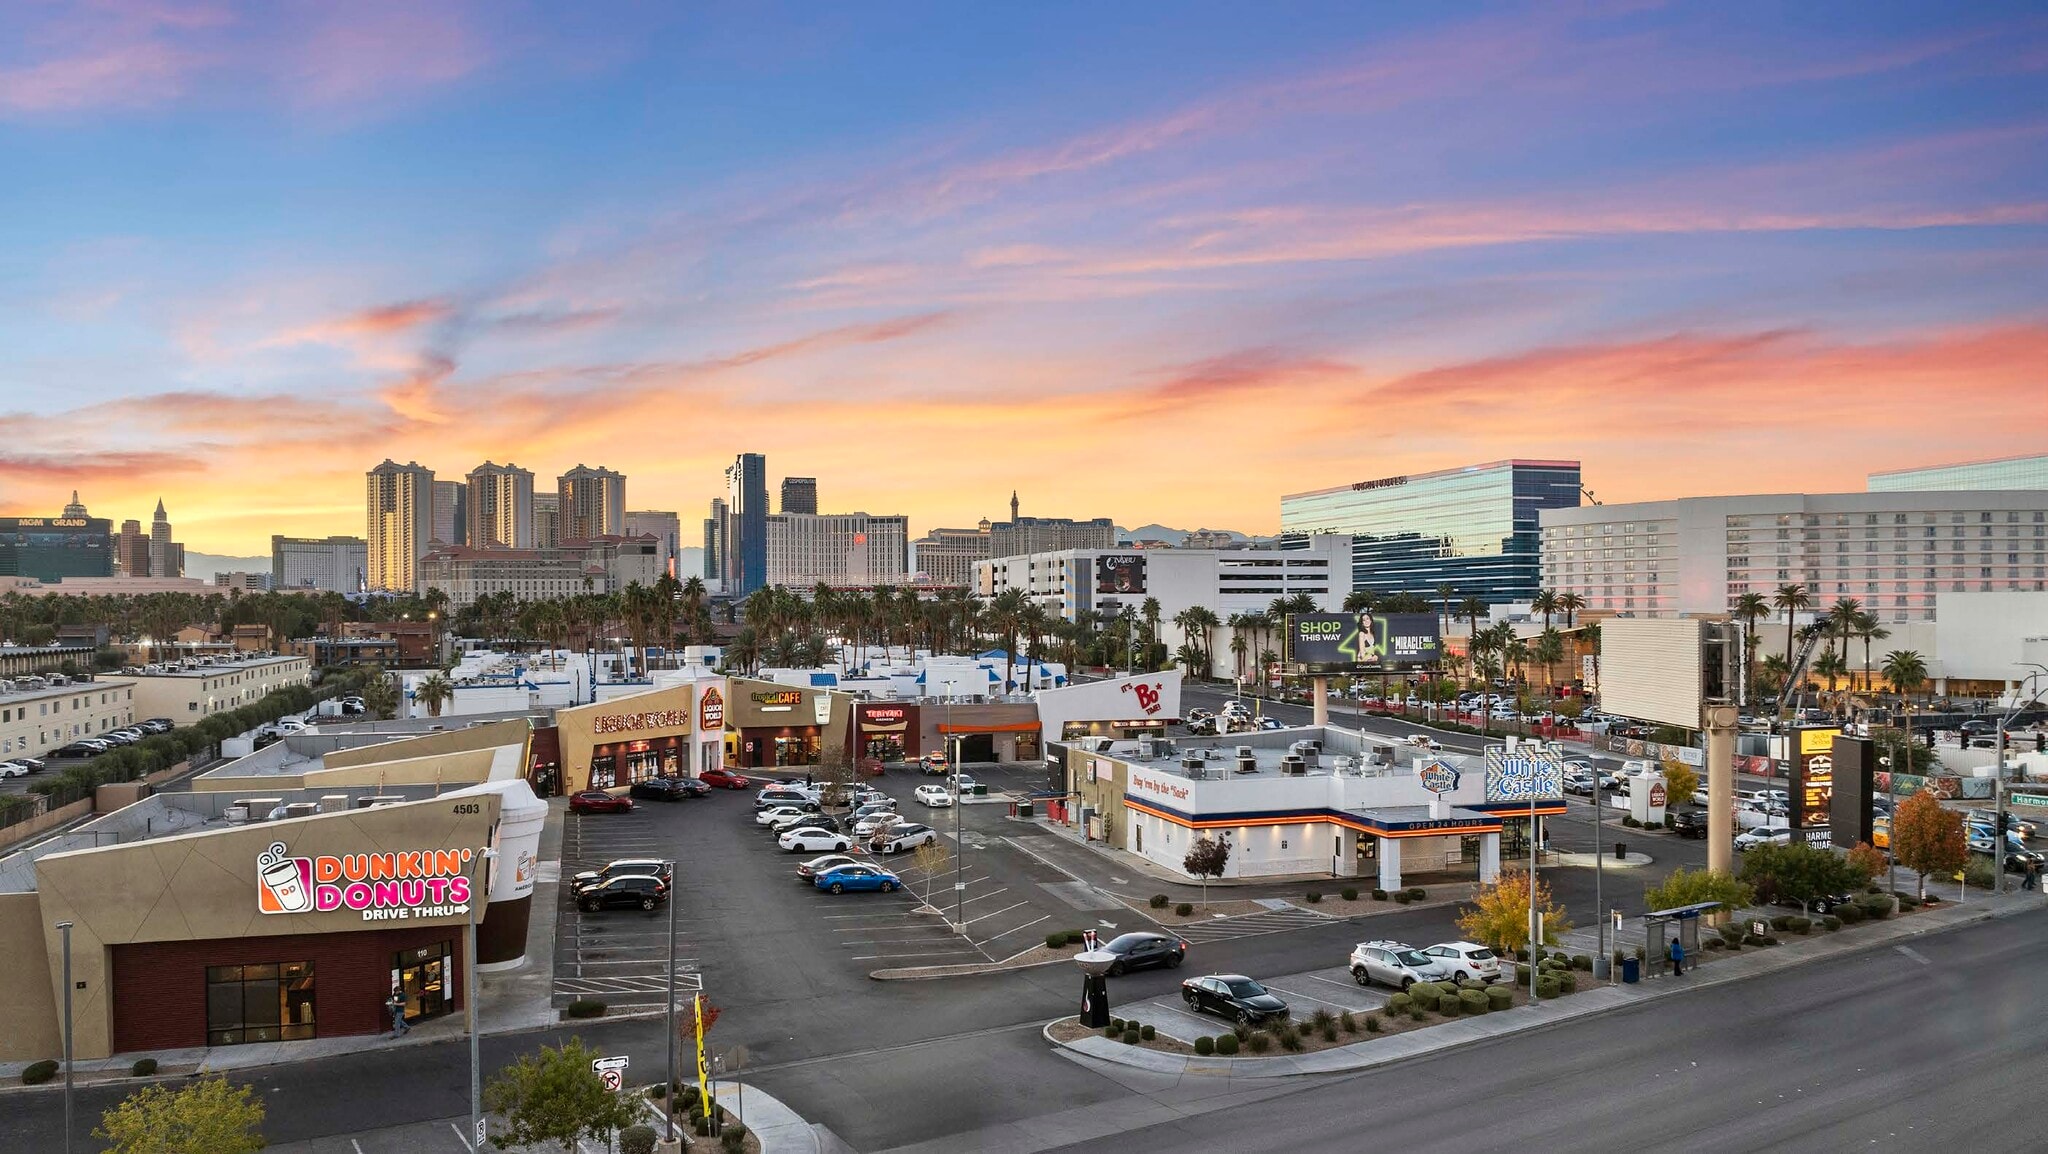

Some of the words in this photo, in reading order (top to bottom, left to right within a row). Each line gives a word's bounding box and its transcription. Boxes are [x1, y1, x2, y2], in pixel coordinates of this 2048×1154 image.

[18, 519, 44, 527] MGM
[52, 519, 87, 527] GRAND
[1300, 621, 1342, 634] SHOP
[1322, 633, 1342, 641] WAY
[1395, 636, 1423, 650] MIRACLE
[1120, 682, 1133, 694] IT'S
[778, 692, 801, 704] CAFE
[865, 709, 903, 718] TERIYAKI
[1145, 703, 1162, 716] TIME!
[594, 712, 645, 734] LIQUOR
[645, 708, 688, 729] WORLD
[1502, 758, 1551, 778] White
[1425, 771, 1451, 782] White
[1422, 780, 1451, 789] Castle
[1499, 776, 1553, 795] Castle
[453, 804, 480, 815] 4503
[1409, 822, 1434, 830] OPEN
[1452, 819, 1484, 828] HOURS
[1805, 831, 1832, 841] HARMO
[315, 847, 472, 883] DUNKIN'
[281, 885, 296, 896] DD
[315, 876, 471, 911] DONUTS
[362, 906, 409, 921] DRIVE
[412, 905, 454, 917] THRU
